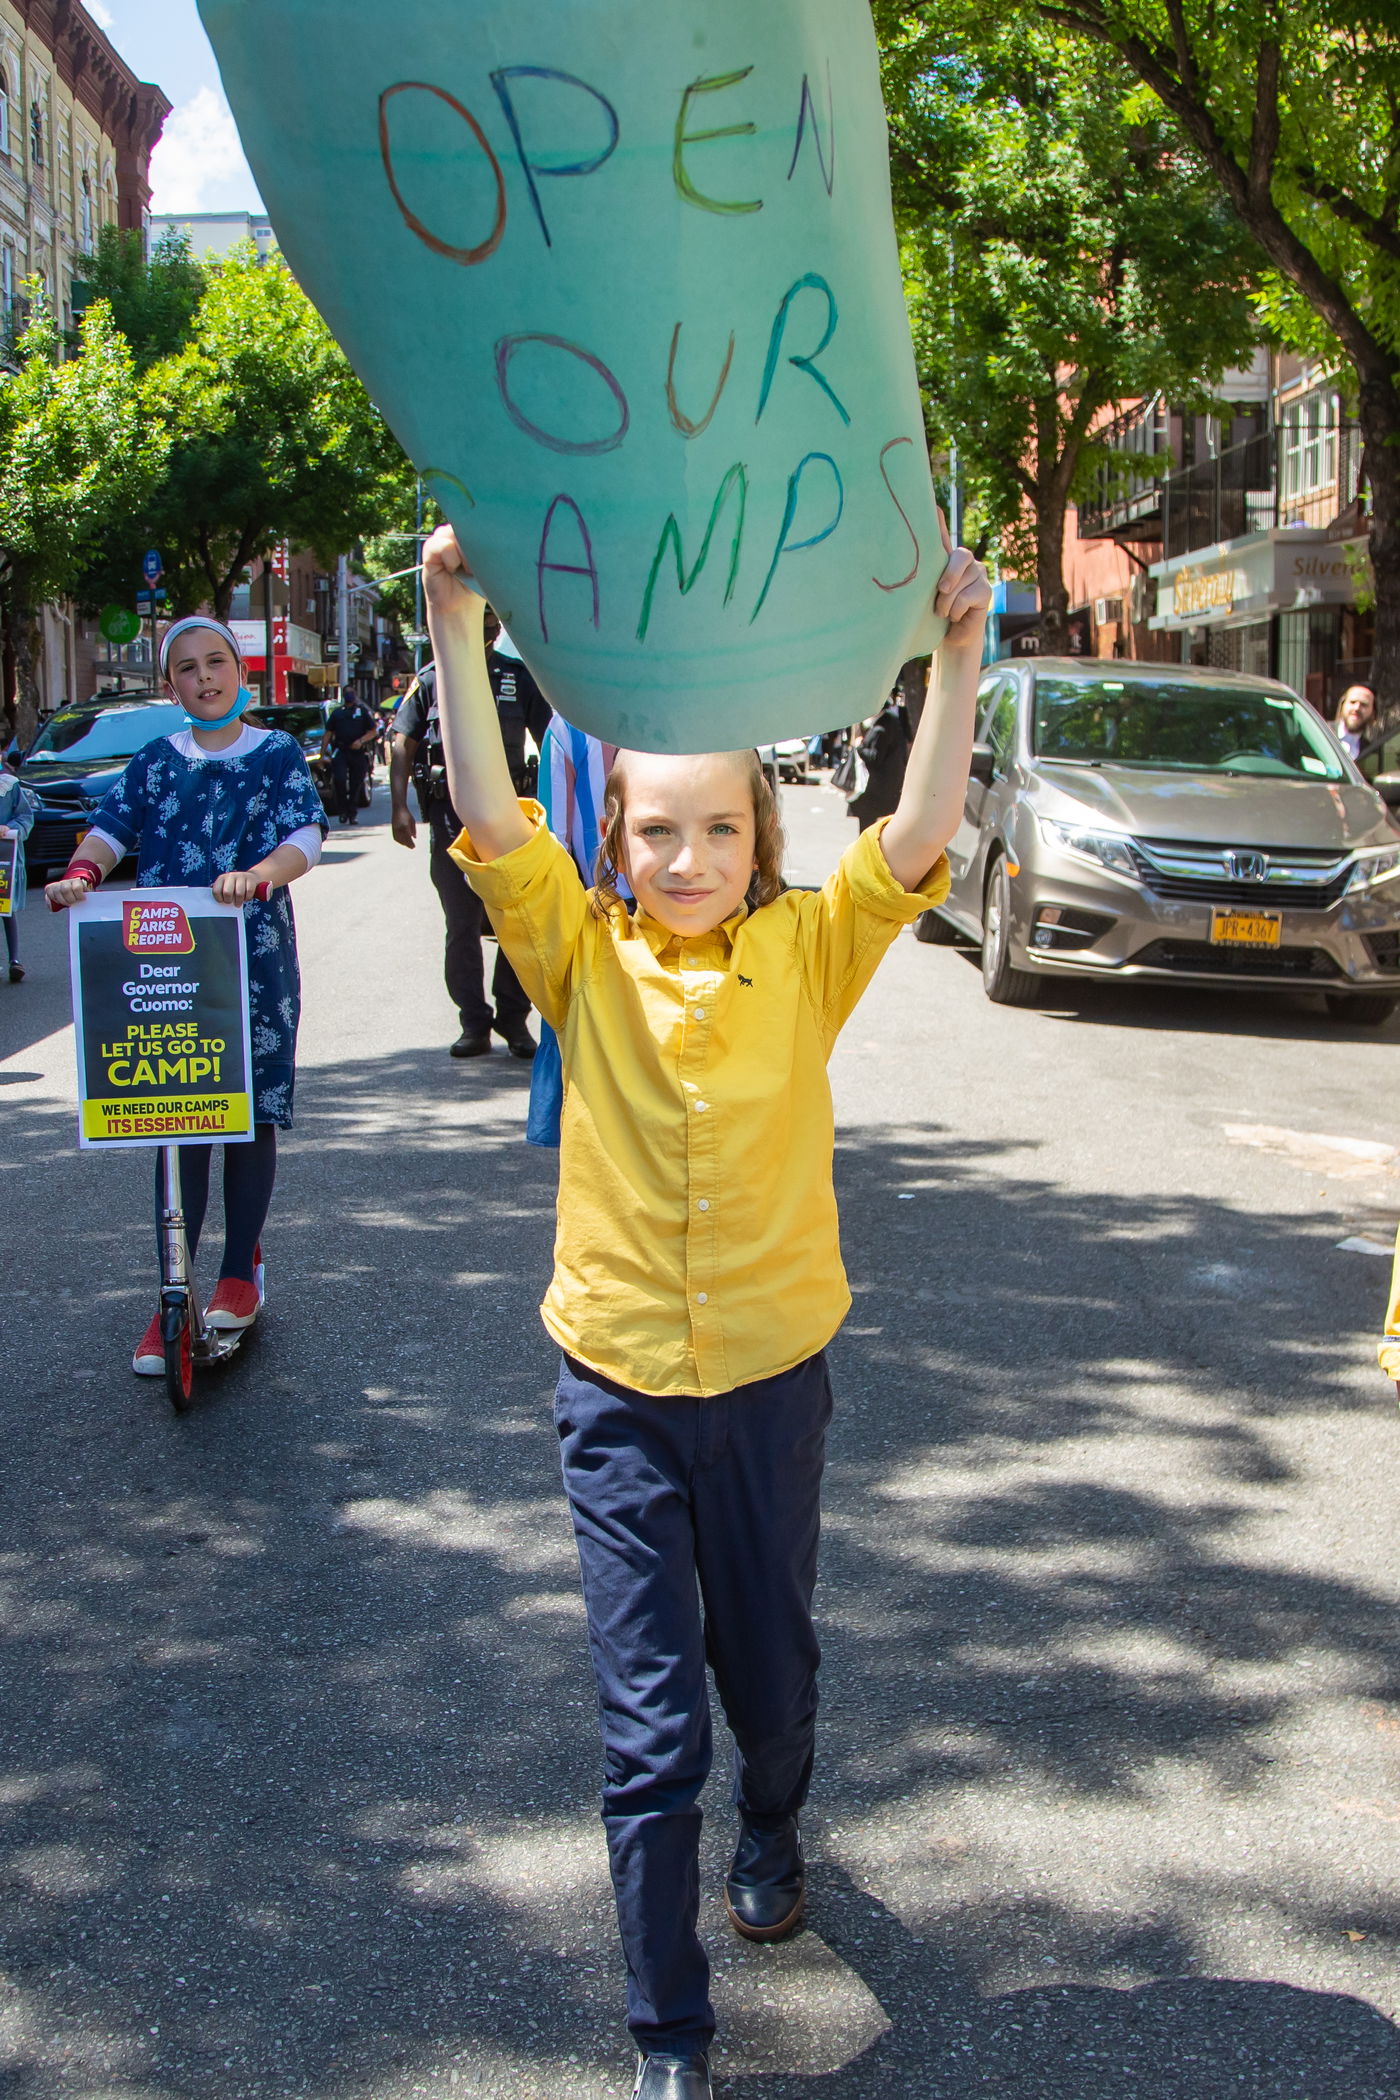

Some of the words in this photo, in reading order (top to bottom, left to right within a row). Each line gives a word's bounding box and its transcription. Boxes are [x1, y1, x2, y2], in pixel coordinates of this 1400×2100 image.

[378, 56, 835, 266] OPEN
[494, 272, 851, 457] OUR
[130, 906, 179, 920] CAMPS
[129, 920, 176, 933] PARKS
[128, 933, 182, 946] REOPEN
[139, 963, 181, 979] Dear
[122, 981, 200, 996] Governor
[129, 997, 193, 1013] Cuomo:
[127, 1023, 198, 1040] PLEASE
[101, 1042, 134, 1058] LET
[138, 1041, 163, 1056] US
[167, 1039, 196, 1054] GO
[199, 1038, 226, 1053] TO
[107, 1056, 222, 1087] CAMP!
[101, 1103, 122, 1116] WE
[123, 1102, 155, 1115] NEED
[157, 1101, 183, 1114] OUR
[185, 1099, 230, 1112] CAMPS
[107, 1118, 132, 1134] ITS
[134, 1114, 226, 1133] ESSENTIAL!
